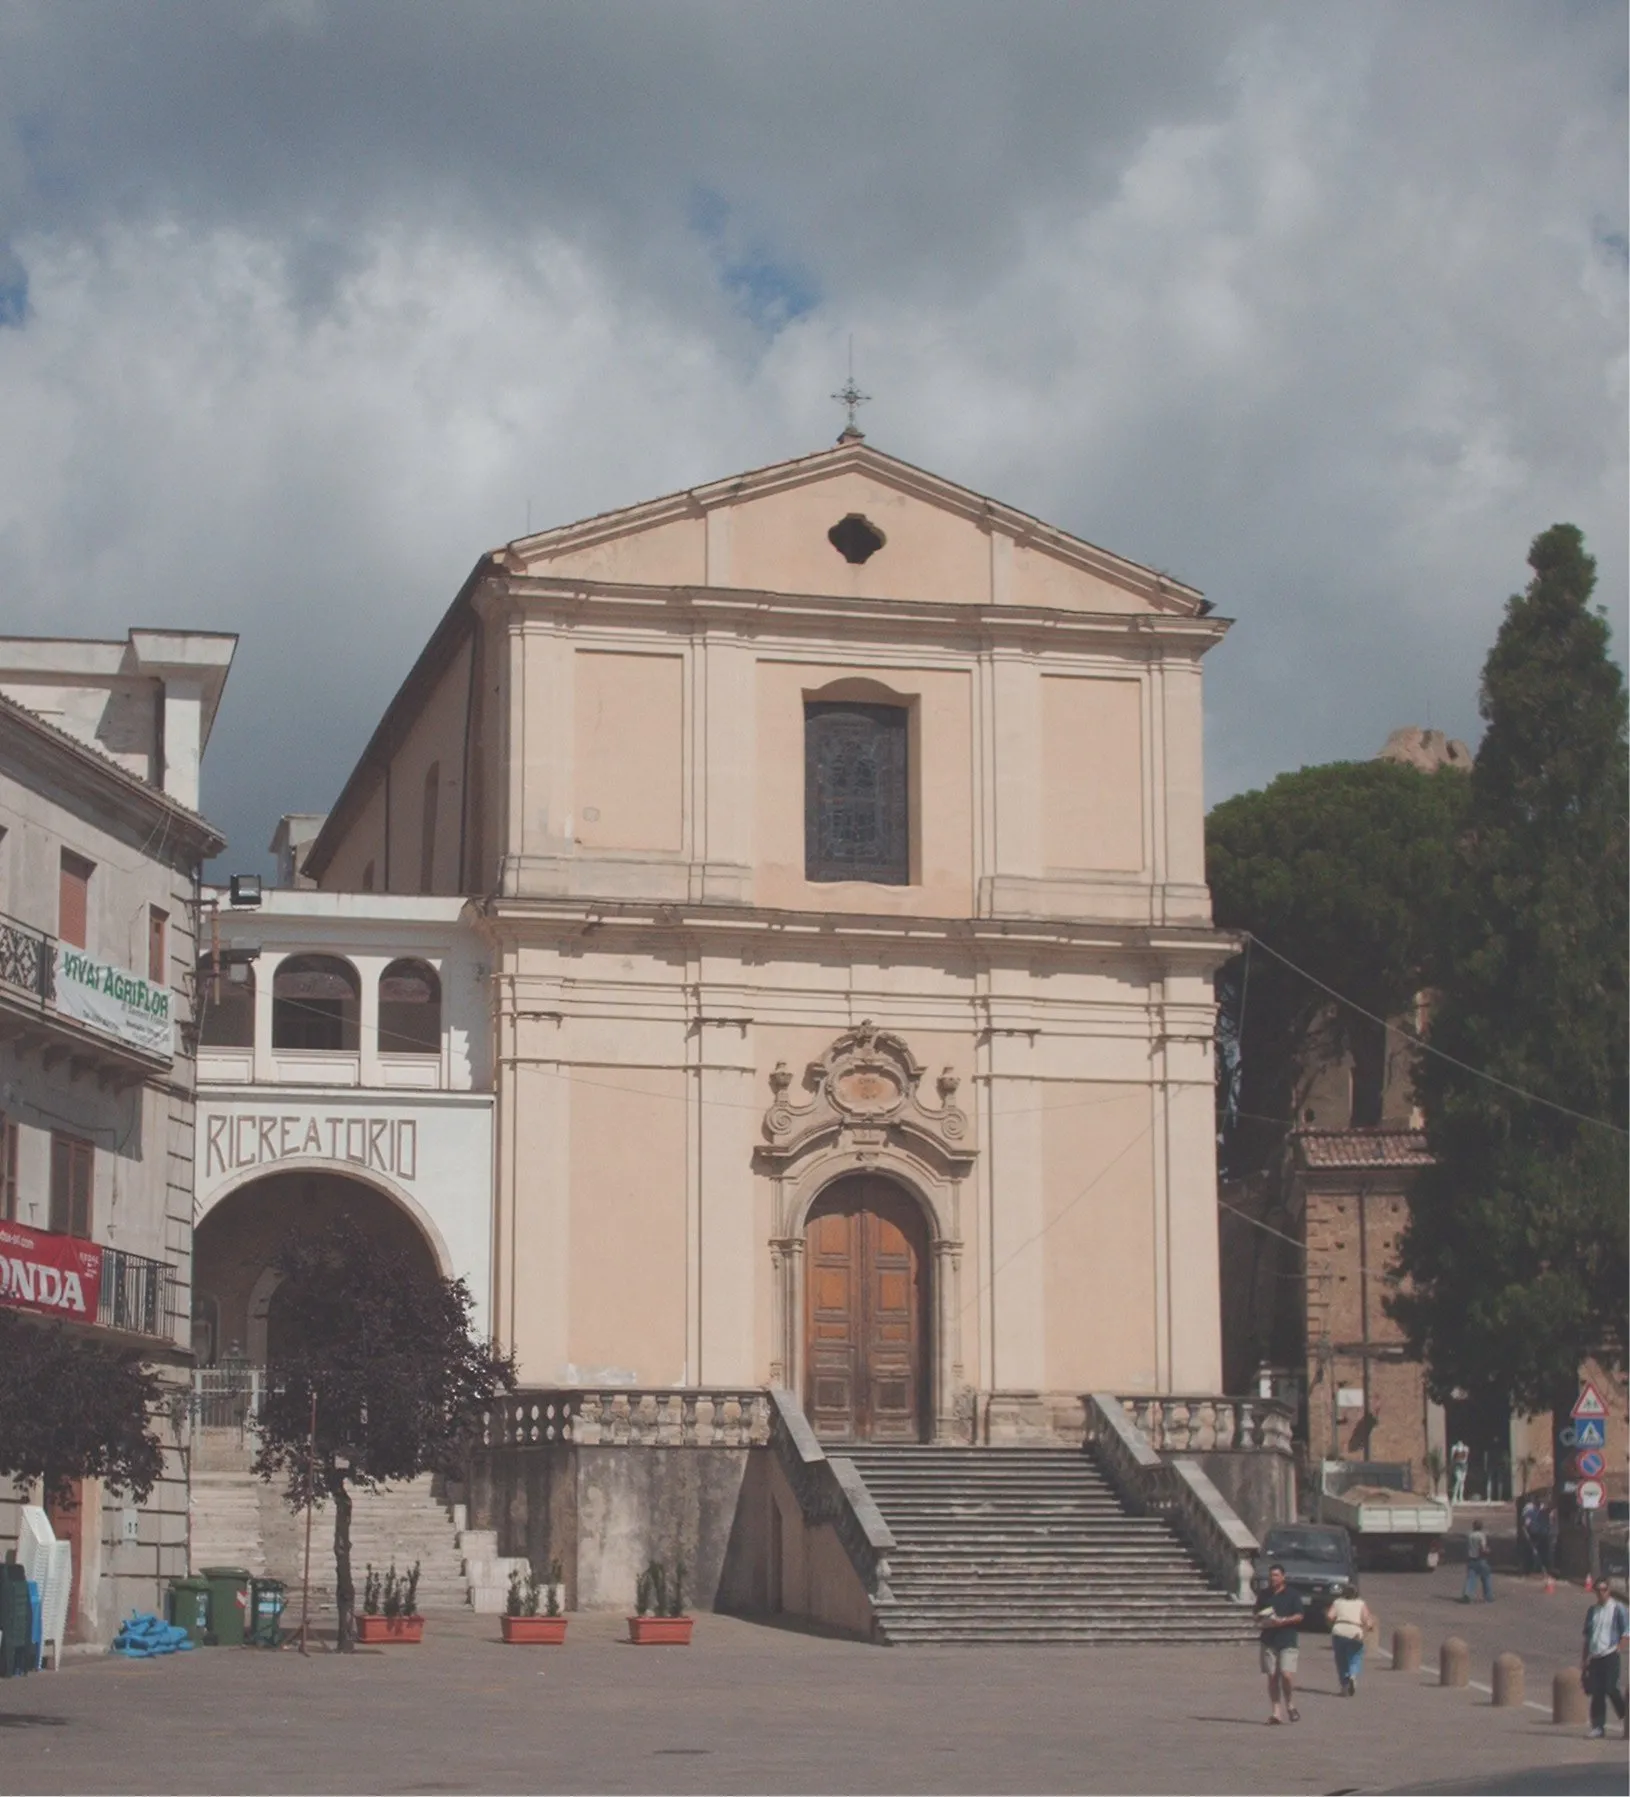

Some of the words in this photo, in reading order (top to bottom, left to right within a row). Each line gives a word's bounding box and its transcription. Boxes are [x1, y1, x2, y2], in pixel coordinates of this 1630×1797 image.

[64, 951, 100, 990] VIVAI
[103, 966, 168, 1019] AGRIFLOR
[206, 1114, 417, 1181] RICREATORIO
